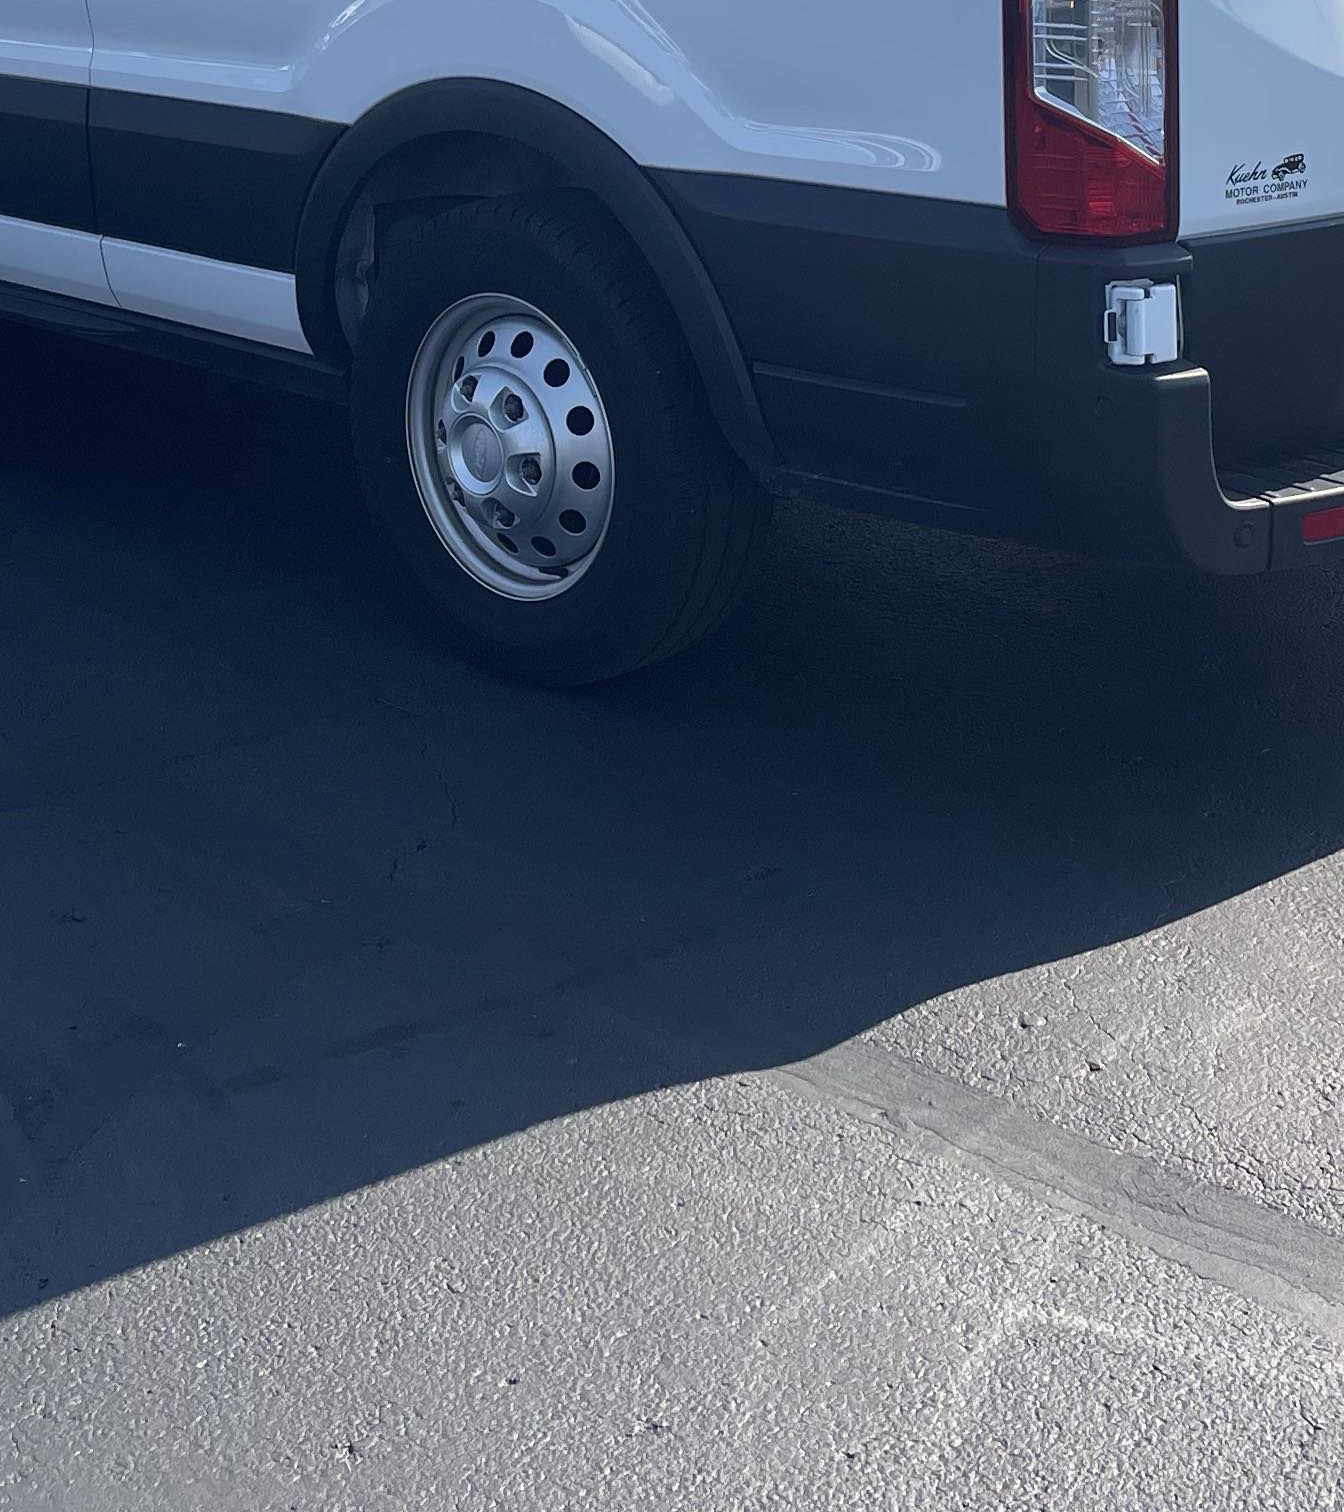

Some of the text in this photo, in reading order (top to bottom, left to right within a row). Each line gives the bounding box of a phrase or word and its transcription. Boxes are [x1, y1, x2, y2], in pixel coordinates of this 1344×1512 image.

[1225, 160, 1268, 186] Kuehn
[1225, 178, 1308, 199] MOTOR COMPANY
